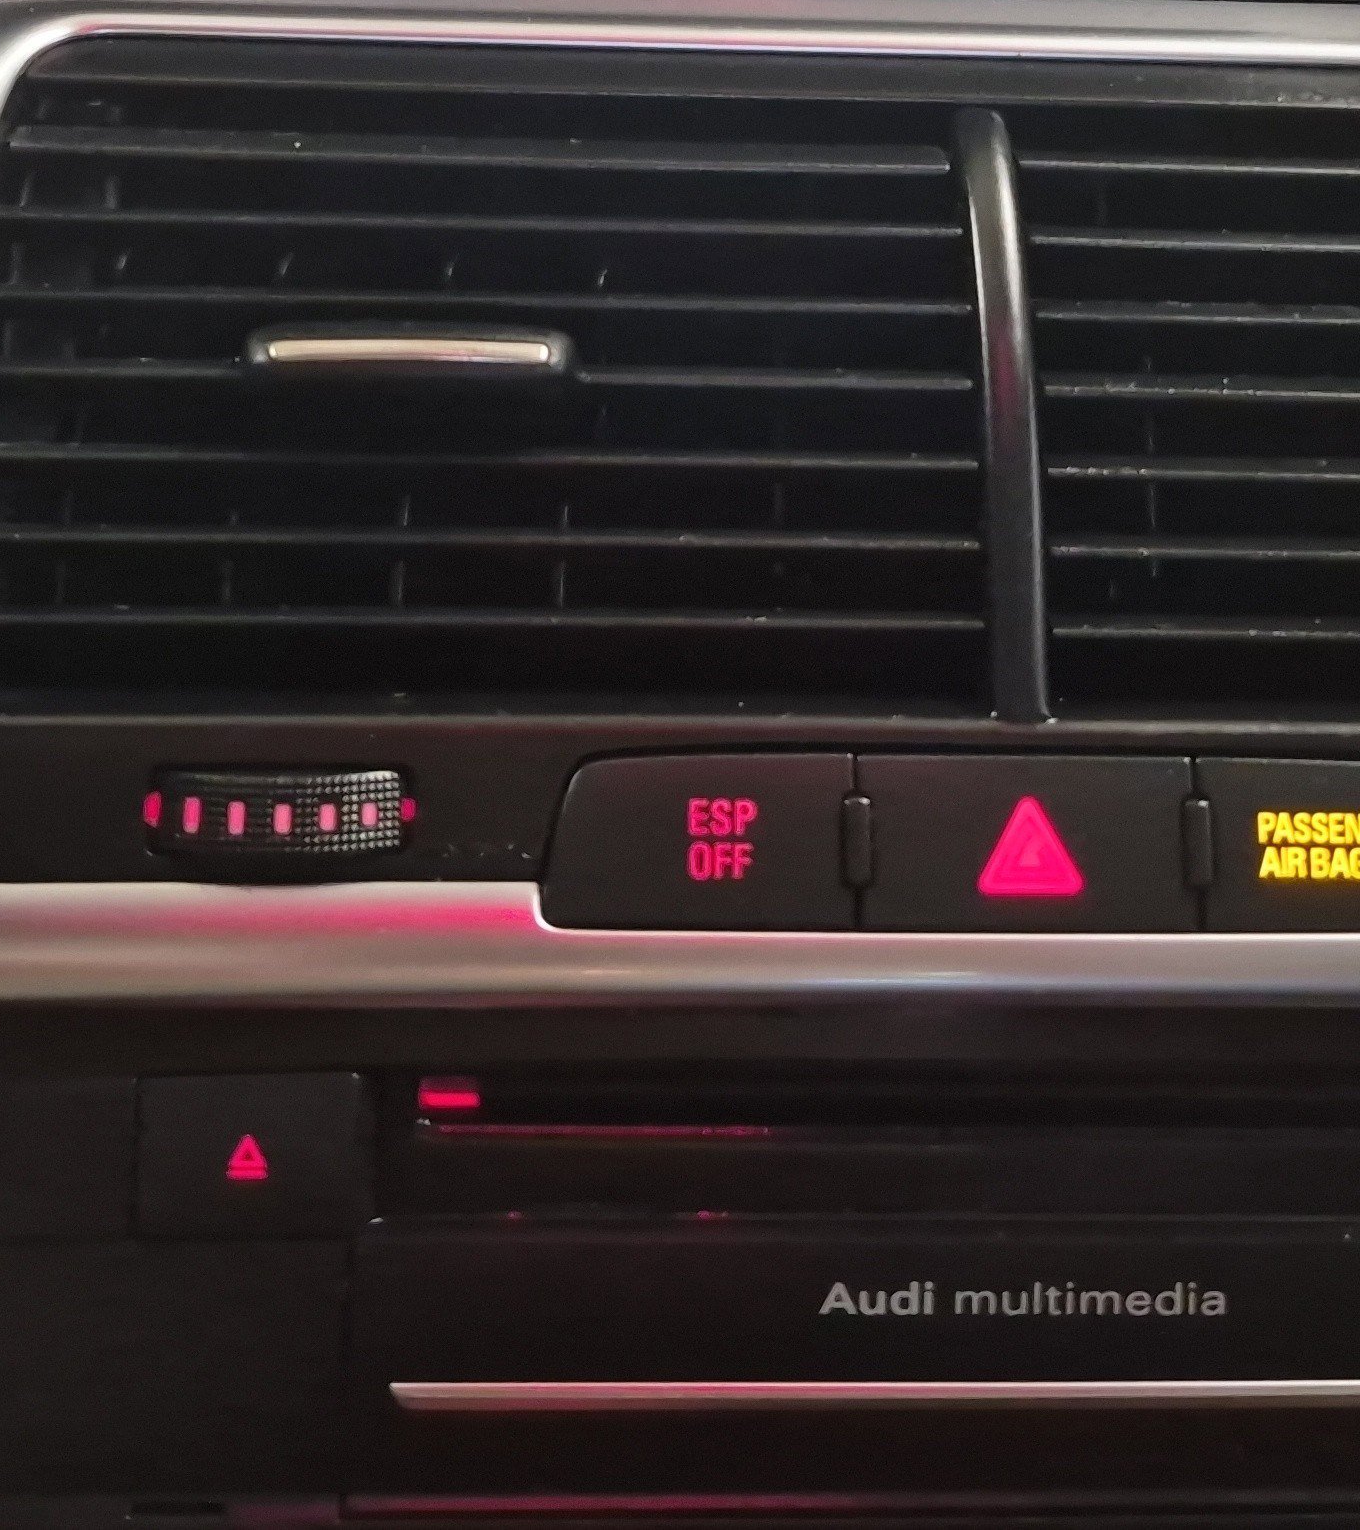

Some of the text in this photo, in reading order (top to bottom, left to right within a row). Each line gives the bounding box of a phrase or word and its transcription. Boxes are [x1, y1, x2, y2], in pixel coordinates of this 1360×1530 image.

[688, 797, 758, 837] ESP
[688, 840, 753, 881] OFF
[818, 1280, 1226, 1317] Audi multimedia
